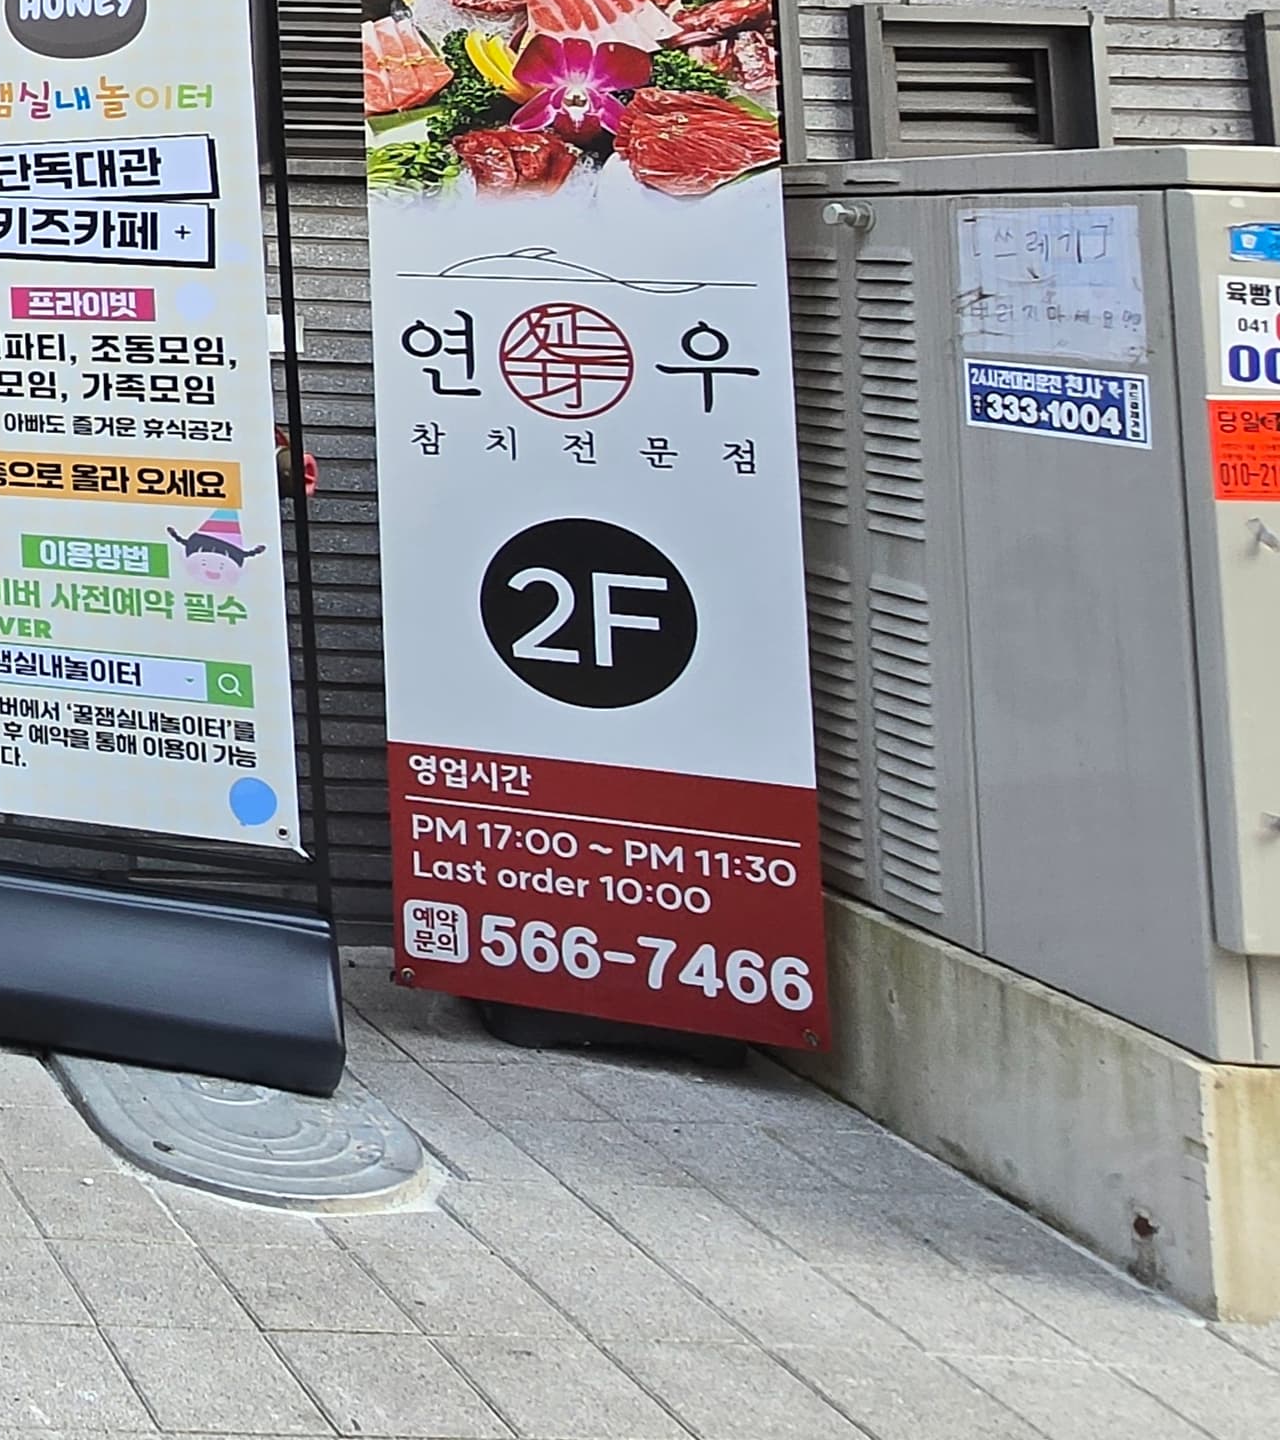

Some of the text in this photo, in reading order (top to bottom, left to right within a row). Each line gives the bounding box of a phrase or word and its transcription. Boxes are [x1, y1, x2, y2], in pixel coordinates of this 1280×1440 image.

[28, 291, 137, 318] 프라이빗
[1227, 281, 1280, 307] 육빵
[1237, 318, 1269, 334] 041
[91, 334, 237, 370] 조동모임,
[401, 309, 482, 397] 연
[656, 320, 760, 413] 우
[82, 372, 216, 405] 가족모임
[4, 412, 66, 435] 아빠도
[73, 415, 137, 438] 즐거운
[143, 418, 233, 442] 휴식공간
[71, 462, 129, 494] 올라
[137, 467, 226, 499] 오세요
[40, 539, 149, 574] 이용방법
[52, 583, 175, 618] 사전예약
[184, 592, 248, 625] 필수
[507, 566, 668, 667] 2F
[3, 720, 23, 740] 후
[29, 723, 89, 750] 예약을
[96, 731, 137, 756] 통해
[143, 738, 207, 763] 이용이
[213, 743, 256, 768] 가능
[408, 753, 532, 797] 영업시간
[411, 814, 468, 845] PM
[477, 822, 578, 859] 17:00
[624, 839, 684, 873] PM
[694, 849, 797, 887] 11:30
[412, 851, 711, 914] Last order 10:00
[412, 907, 459, 932] 예약
[412, 929, 459, 956] 문의
[480, 913, 813, 1011] 566-7466
